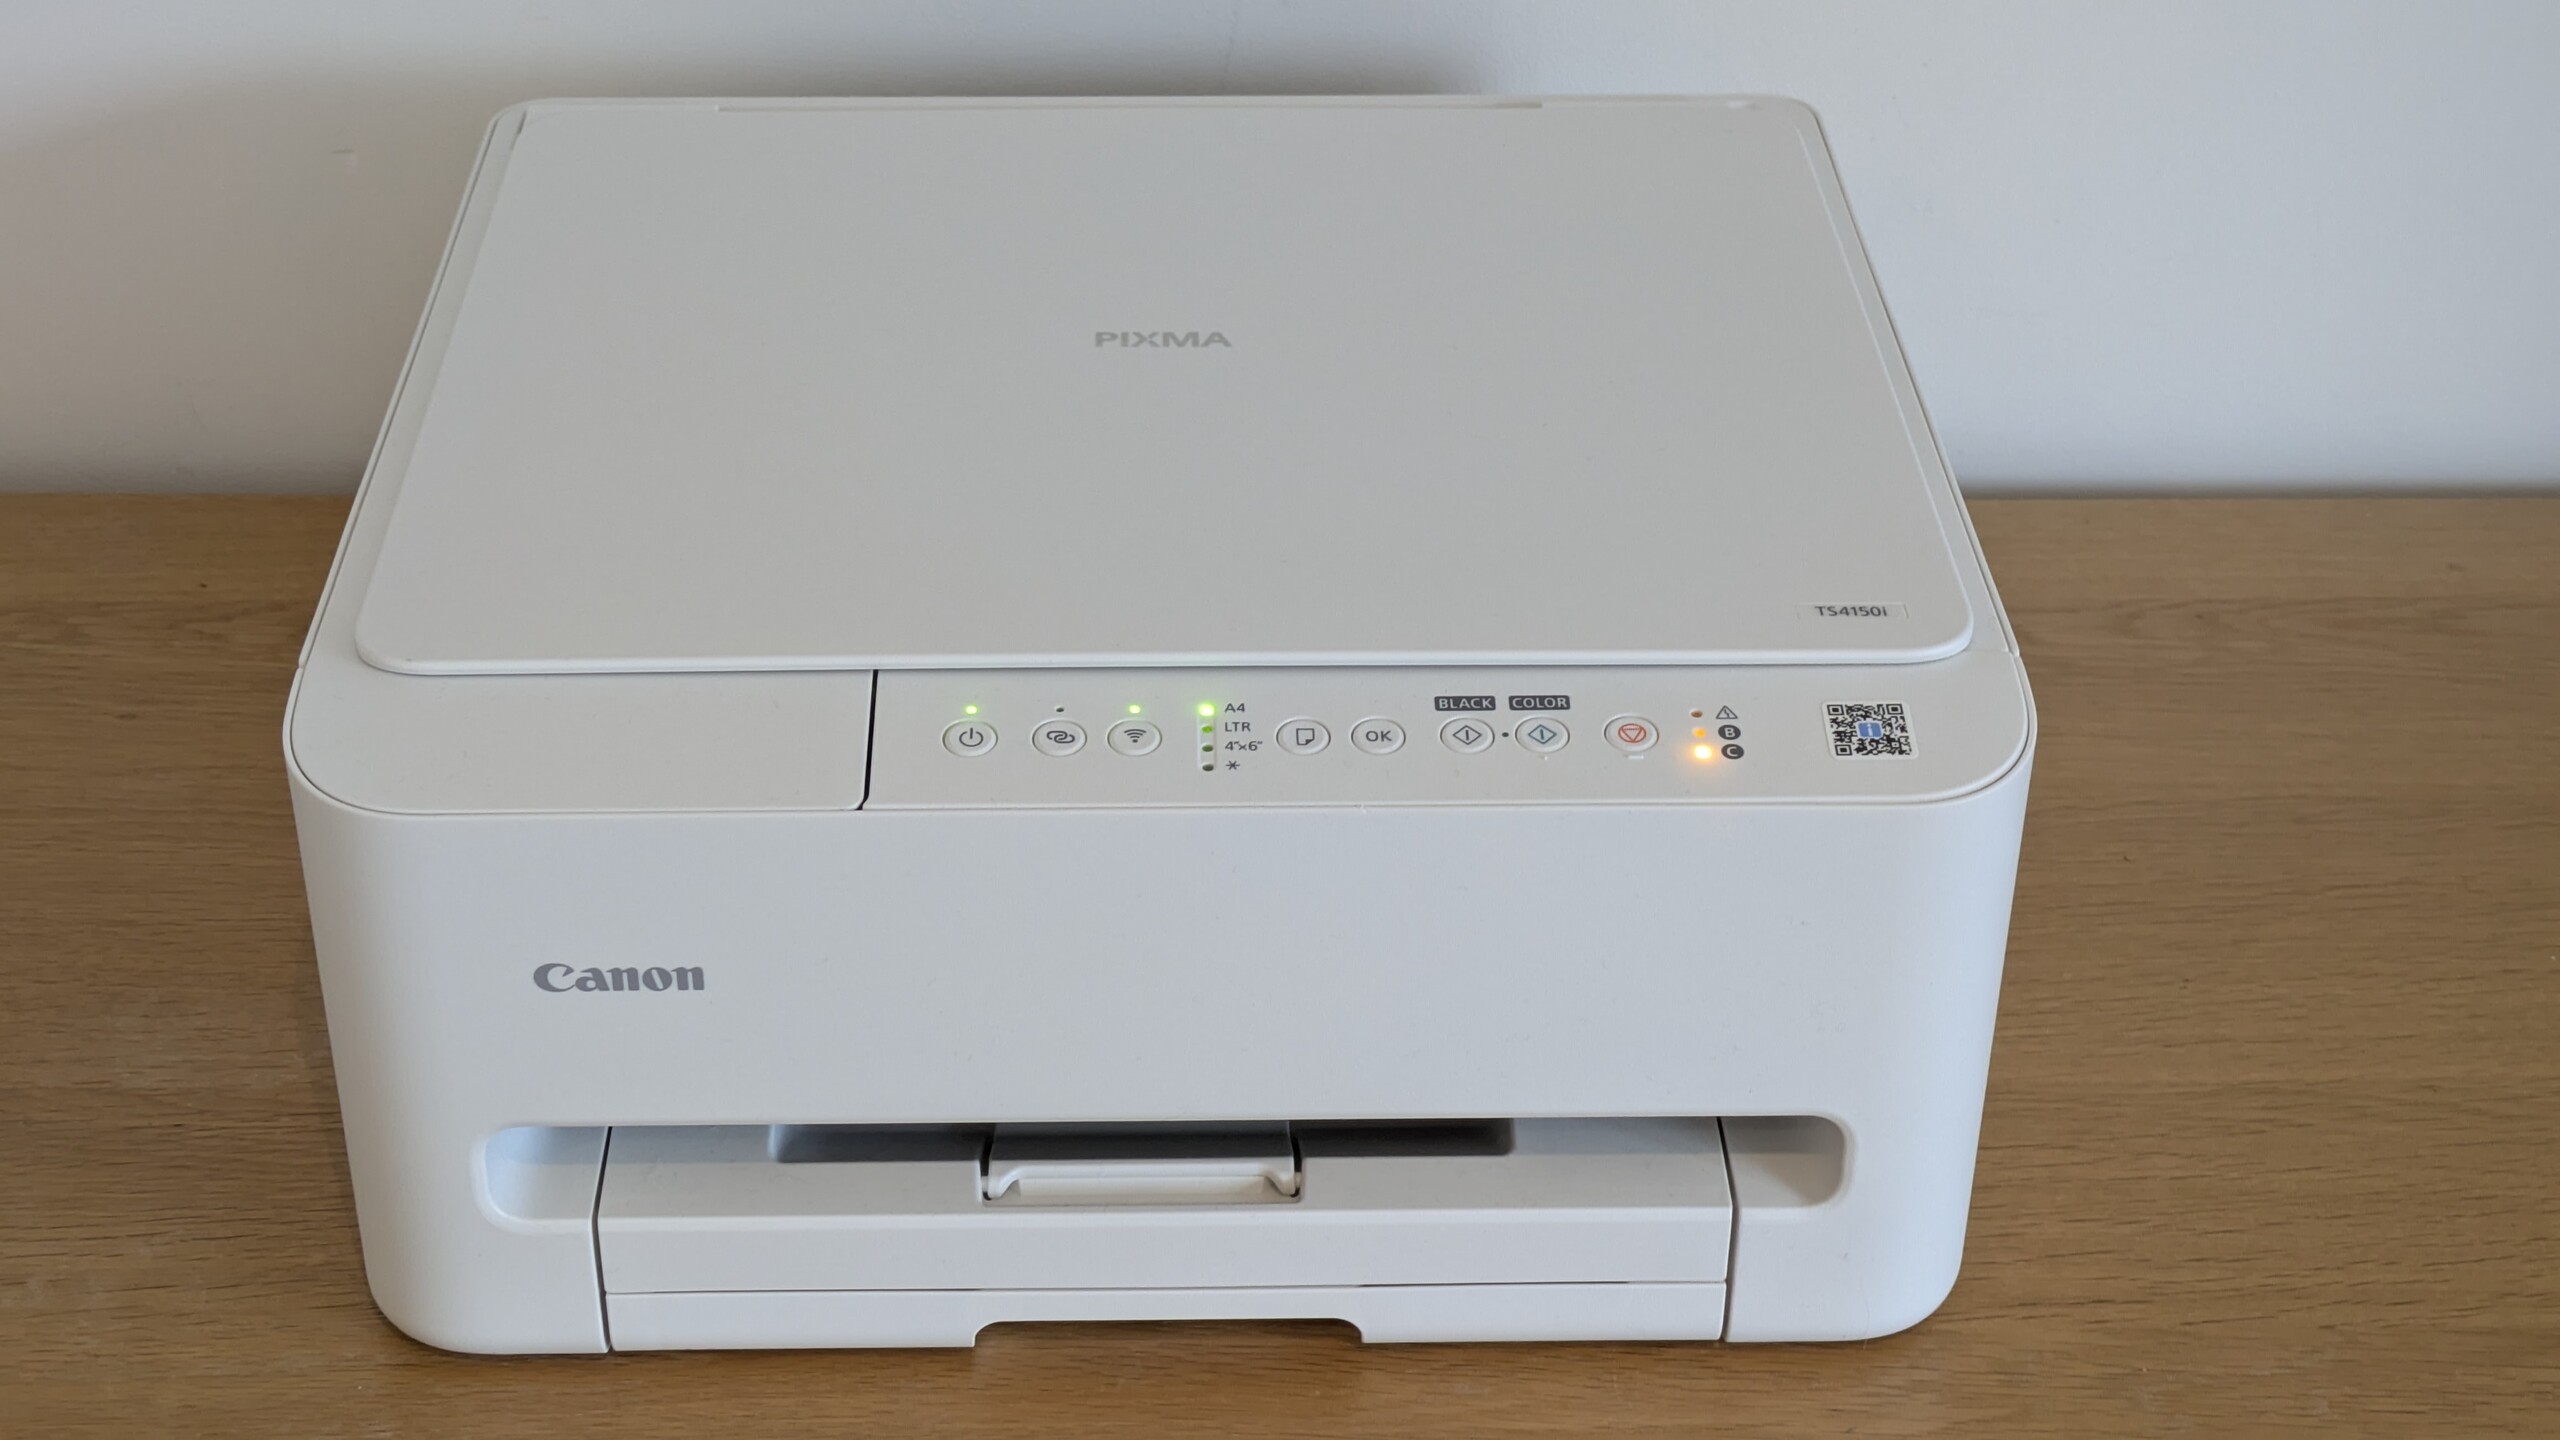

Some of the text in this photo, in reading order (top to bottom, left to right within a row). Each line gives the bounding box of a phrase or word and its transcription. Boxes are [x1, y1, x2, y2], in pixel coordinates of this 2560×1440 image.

[1095, 331, 1232, 347] PIXMA
[1814, 606, 1887, 617] TS4150i
[1225, 703, 1245, 713] A4
[1438, 697, 1493, 709] BLACK
[1512, 696, 1568, 709] COLOR
[1225, 722, 1251, 732] LTR
[1365, 730, 1392, 742] OK
[533, 963, 705, 992] Canon
